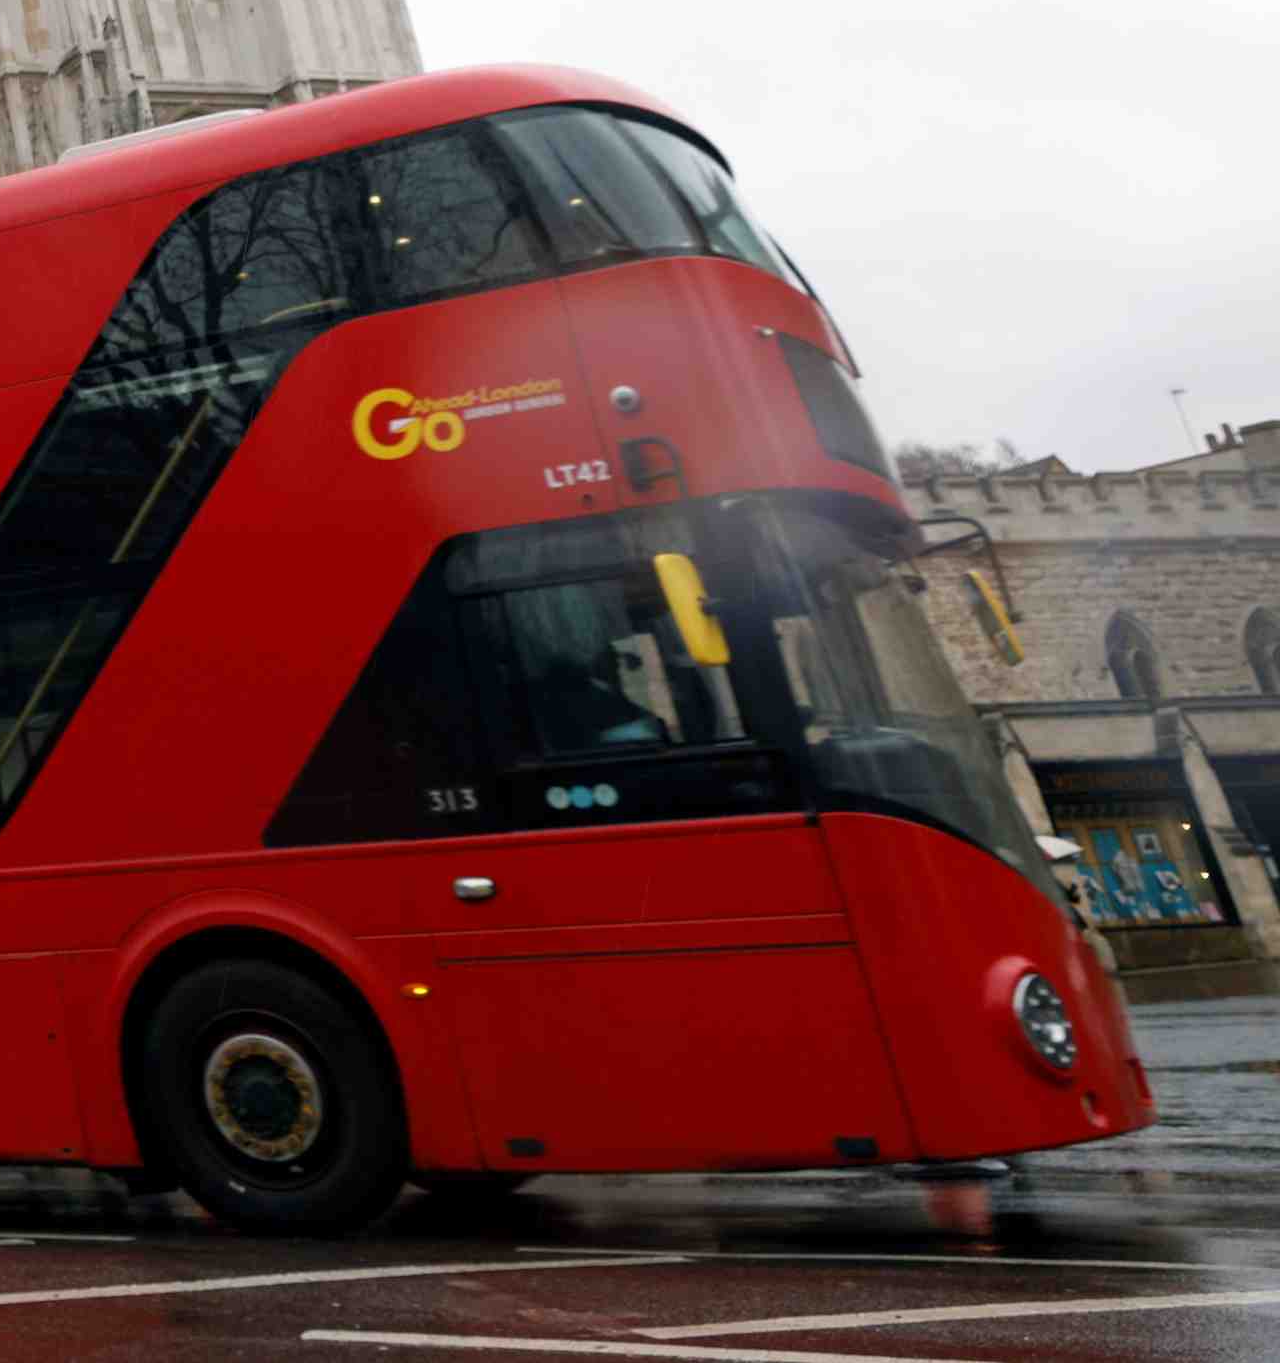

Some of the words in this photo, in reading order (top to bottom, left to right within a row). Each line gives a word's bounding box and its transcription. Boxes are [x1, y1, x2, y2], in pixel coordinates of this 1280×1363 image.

[352, 387, 465, 461] Go
[543, 460, 613, 489] LT42
[428, 787, 479, 812] 313
